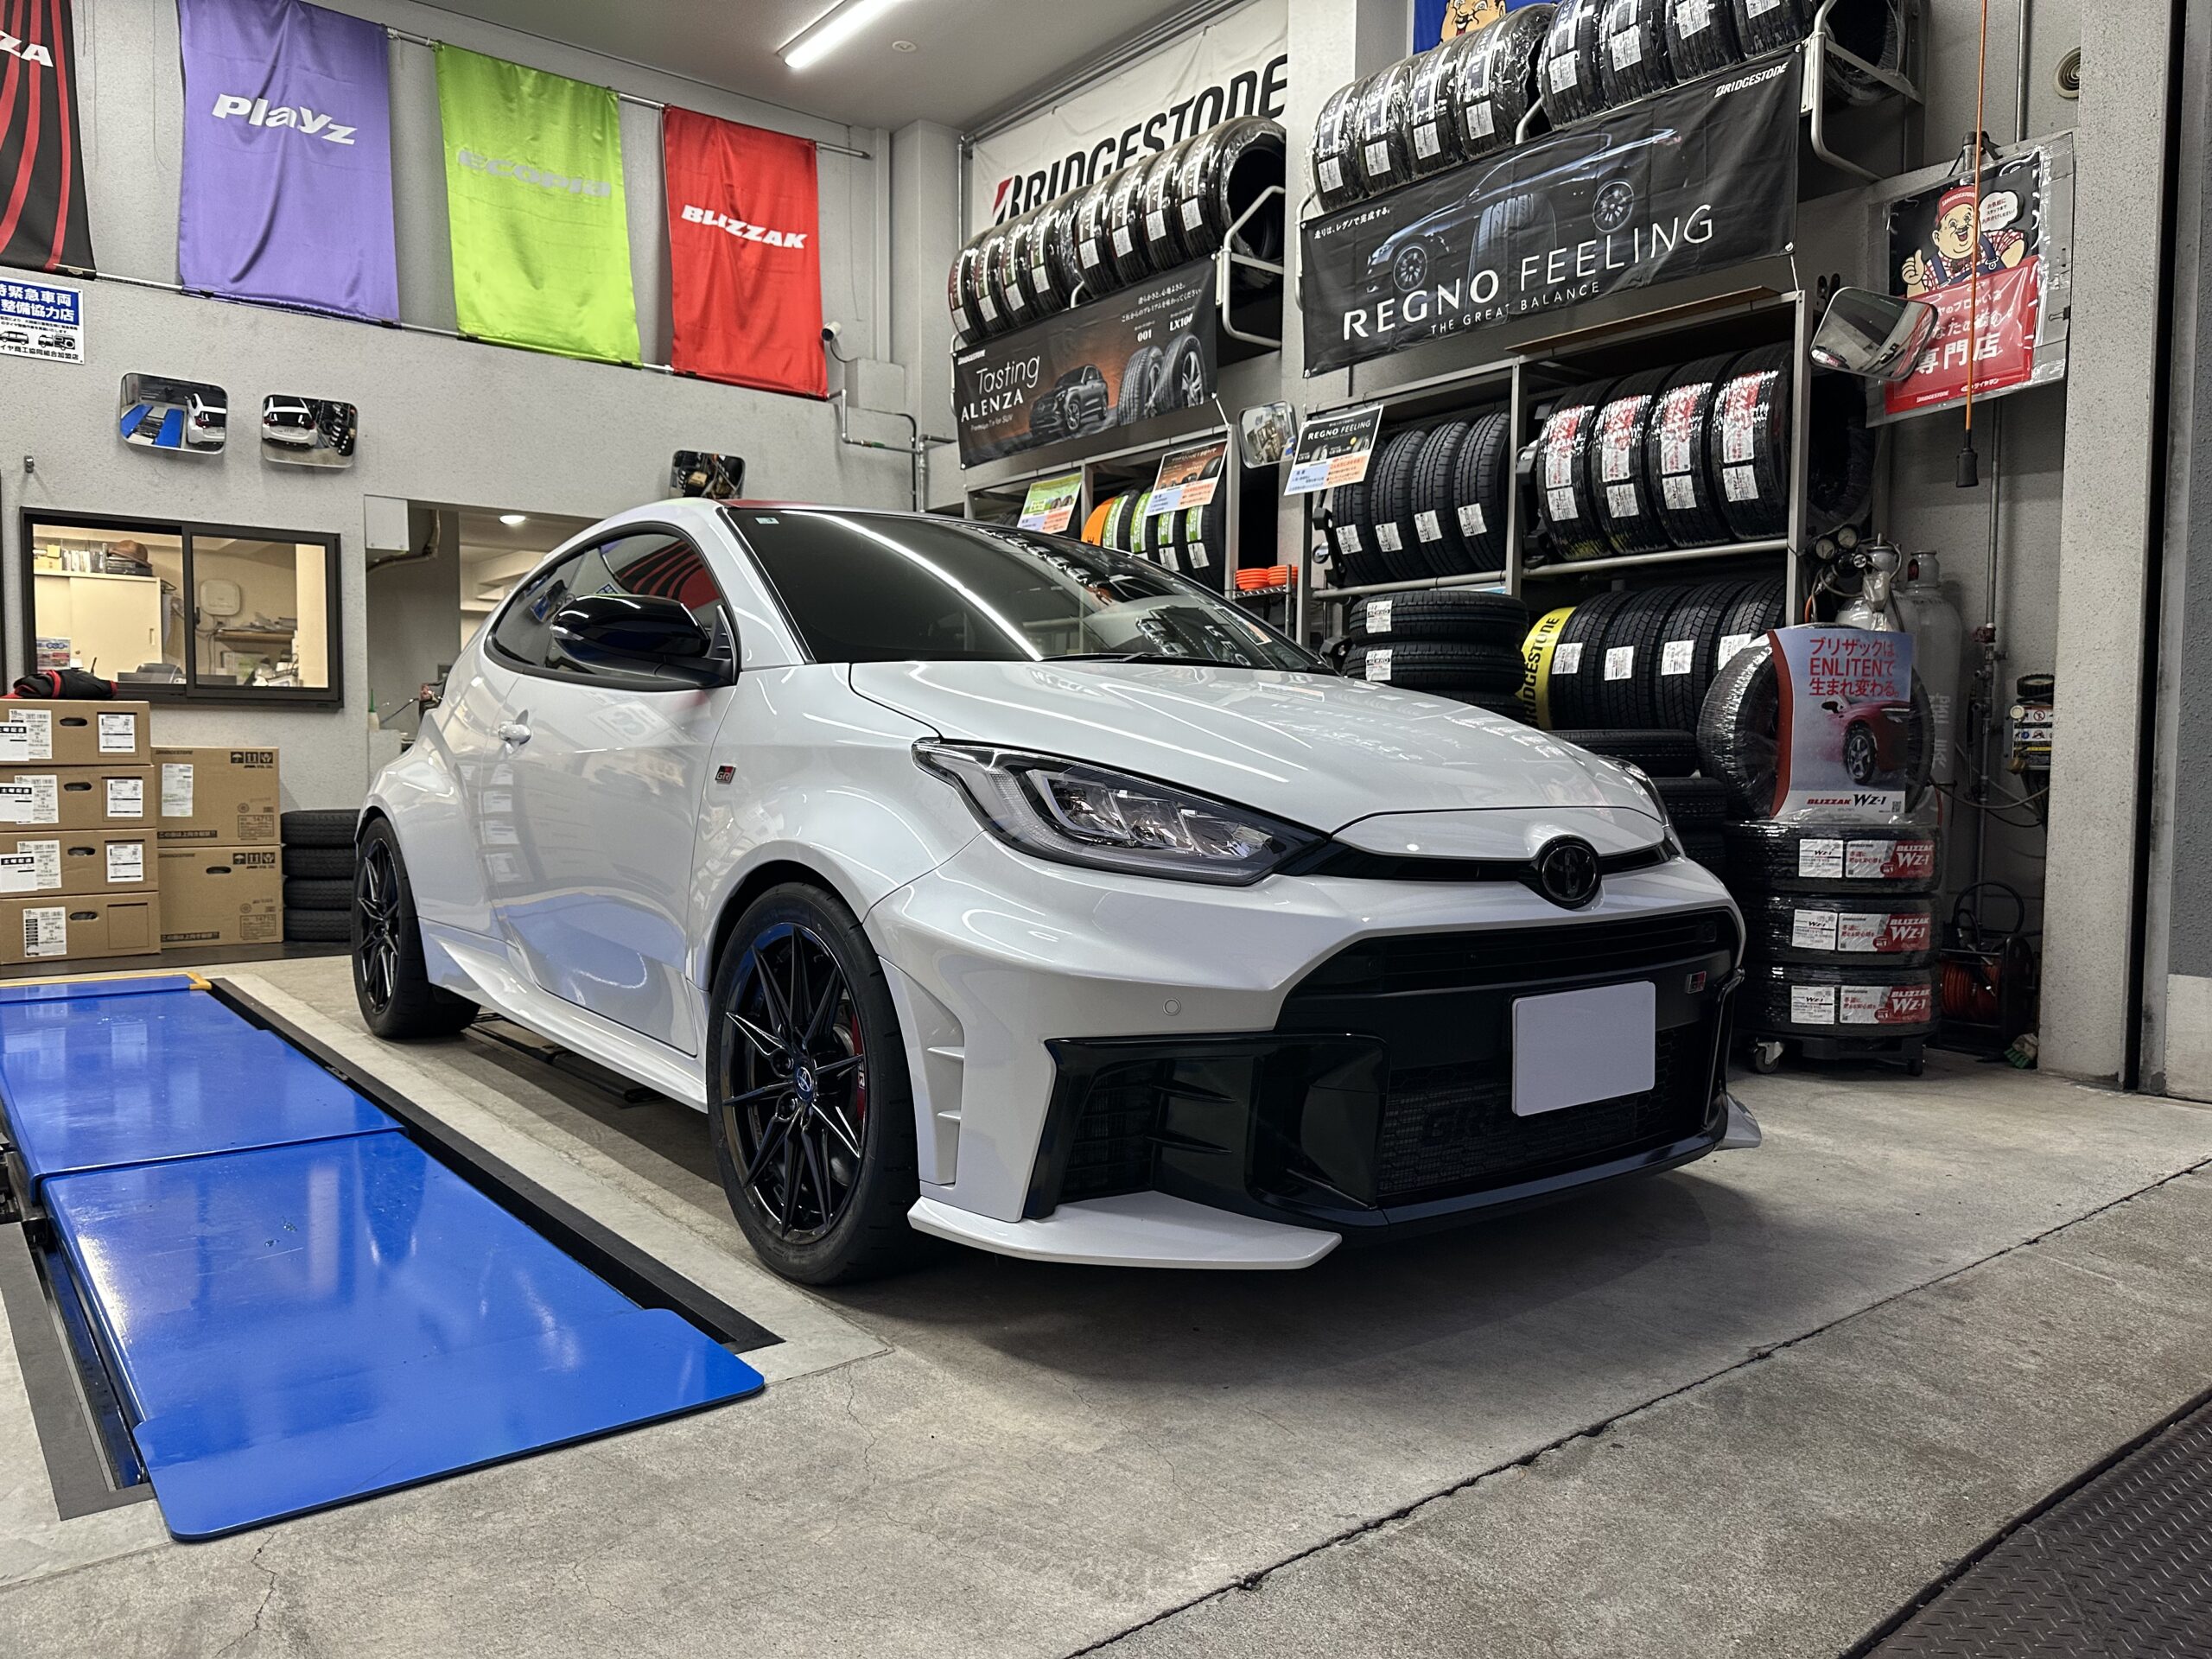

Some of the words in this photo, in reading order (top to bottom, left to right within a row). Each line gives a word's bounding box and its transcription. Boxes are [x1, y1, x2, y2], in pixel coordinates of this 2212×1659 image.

[1714, 62, 1789, 98] BRIDGESTONE
[212, 93, 358, 145] Playz
[994, 54, 1287, 226] BRIDGESTONE
[681, 204, 808, 249] BLIZZAK
[1343, 269, 1500, 340] REGNO
[1520, 204, 1713, 292] FEELING
[1, 299, 75, 322] 整備協力店
[1430, 320, 1455, 334] THE
[1464, 304, 1510, 324] GREAT
[1521, 283, 1599, 311] BALANCE
[1936, 289, 2002, 316] ヤのプロがいる
[1137, 328, 1152, 342] 001
[1916, 333, 2001, 374] 専門店
[976, 355, 1040, 395] Tasting
[961, 388, 1024, 423] ALENZA
[1307, 428, 1339, 440] REGNO
[1340, 419, 1371, 433] FEELING
[1809, 637, 1895, 656] ブリザックは
[1809, 658, 1895, 677] ENLITENで
[1809, 678, 1899, 698] 生まれ変わる。
[717, 772, 730, 782] GR
[1853, 794, 1887, 807] WZ-1
[1897, 852, 1929, 868] WZ-1
[1890, 926, 1925, 942] WZ-1
[1892, 999, 1926, 1014] WZ-1
